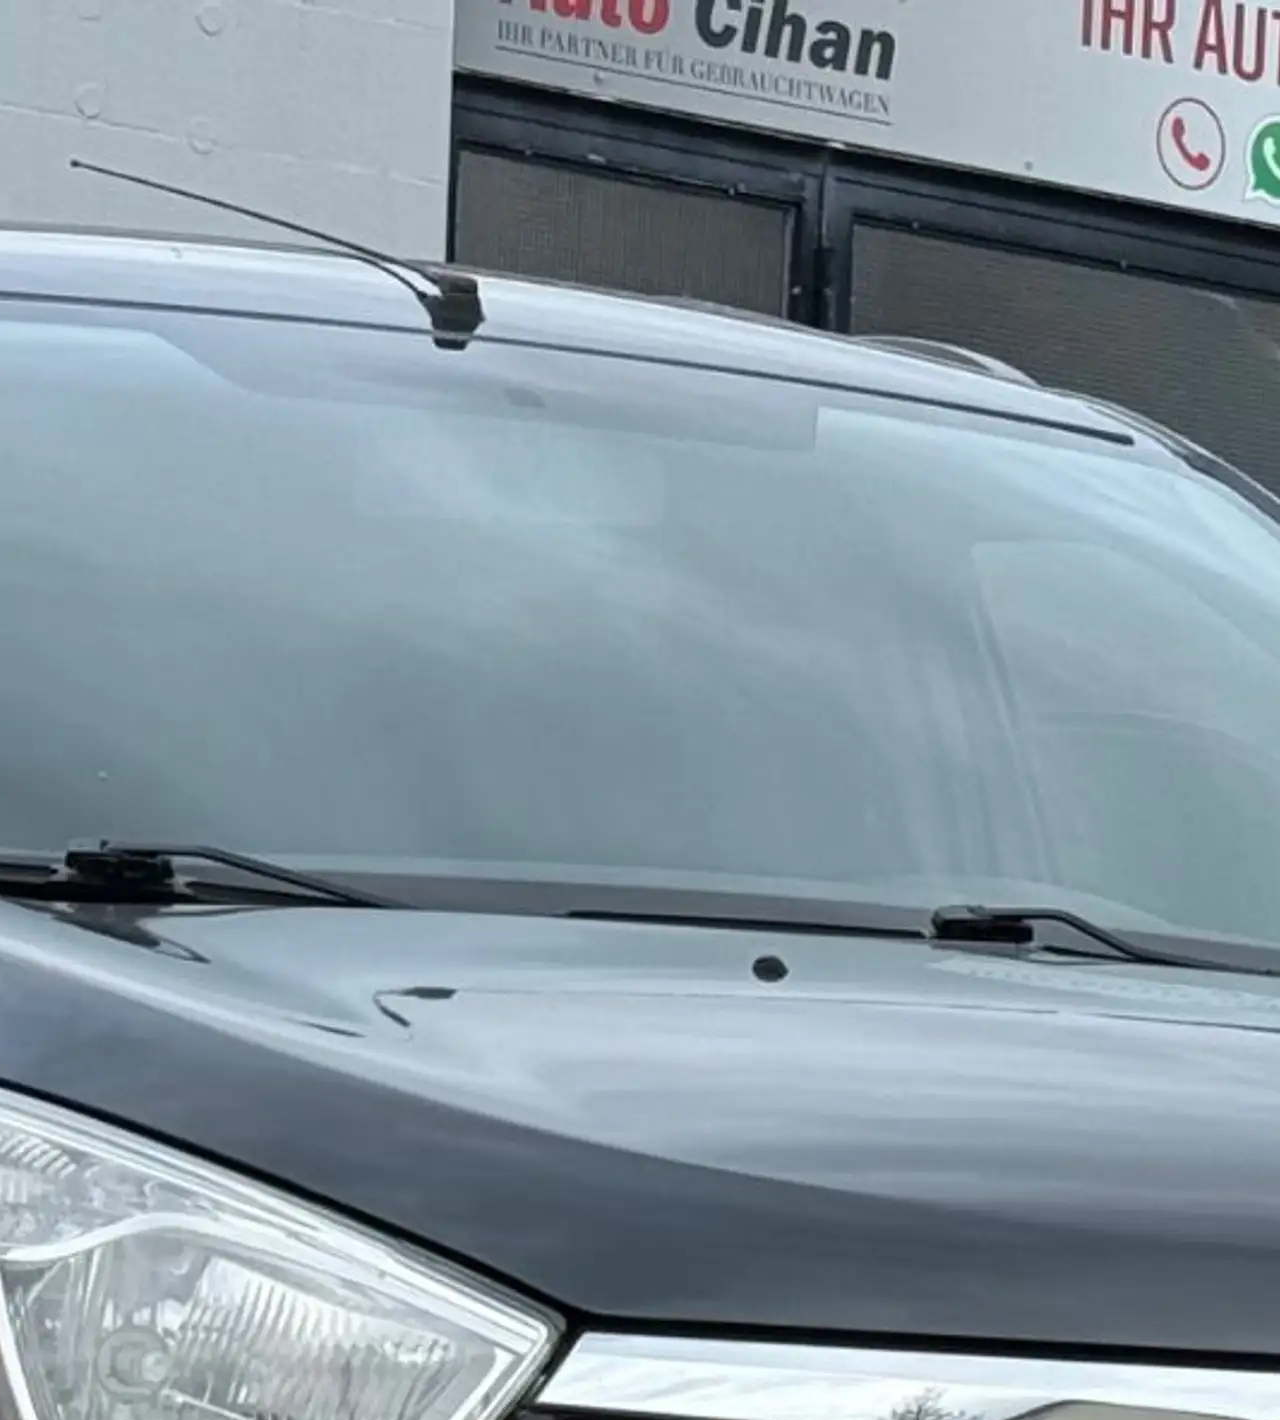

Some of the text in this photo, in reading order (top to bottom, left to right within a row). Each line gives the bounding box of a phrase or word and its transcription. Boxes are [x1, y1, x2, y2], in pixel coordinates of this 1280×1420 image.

[497, 19, 892, 116] IHR PARTNER FÜR GEBRAUCHTWAGEN
[694, 0, 896, 80] Cihan
[1082, 0, 1175, 64] IHR
